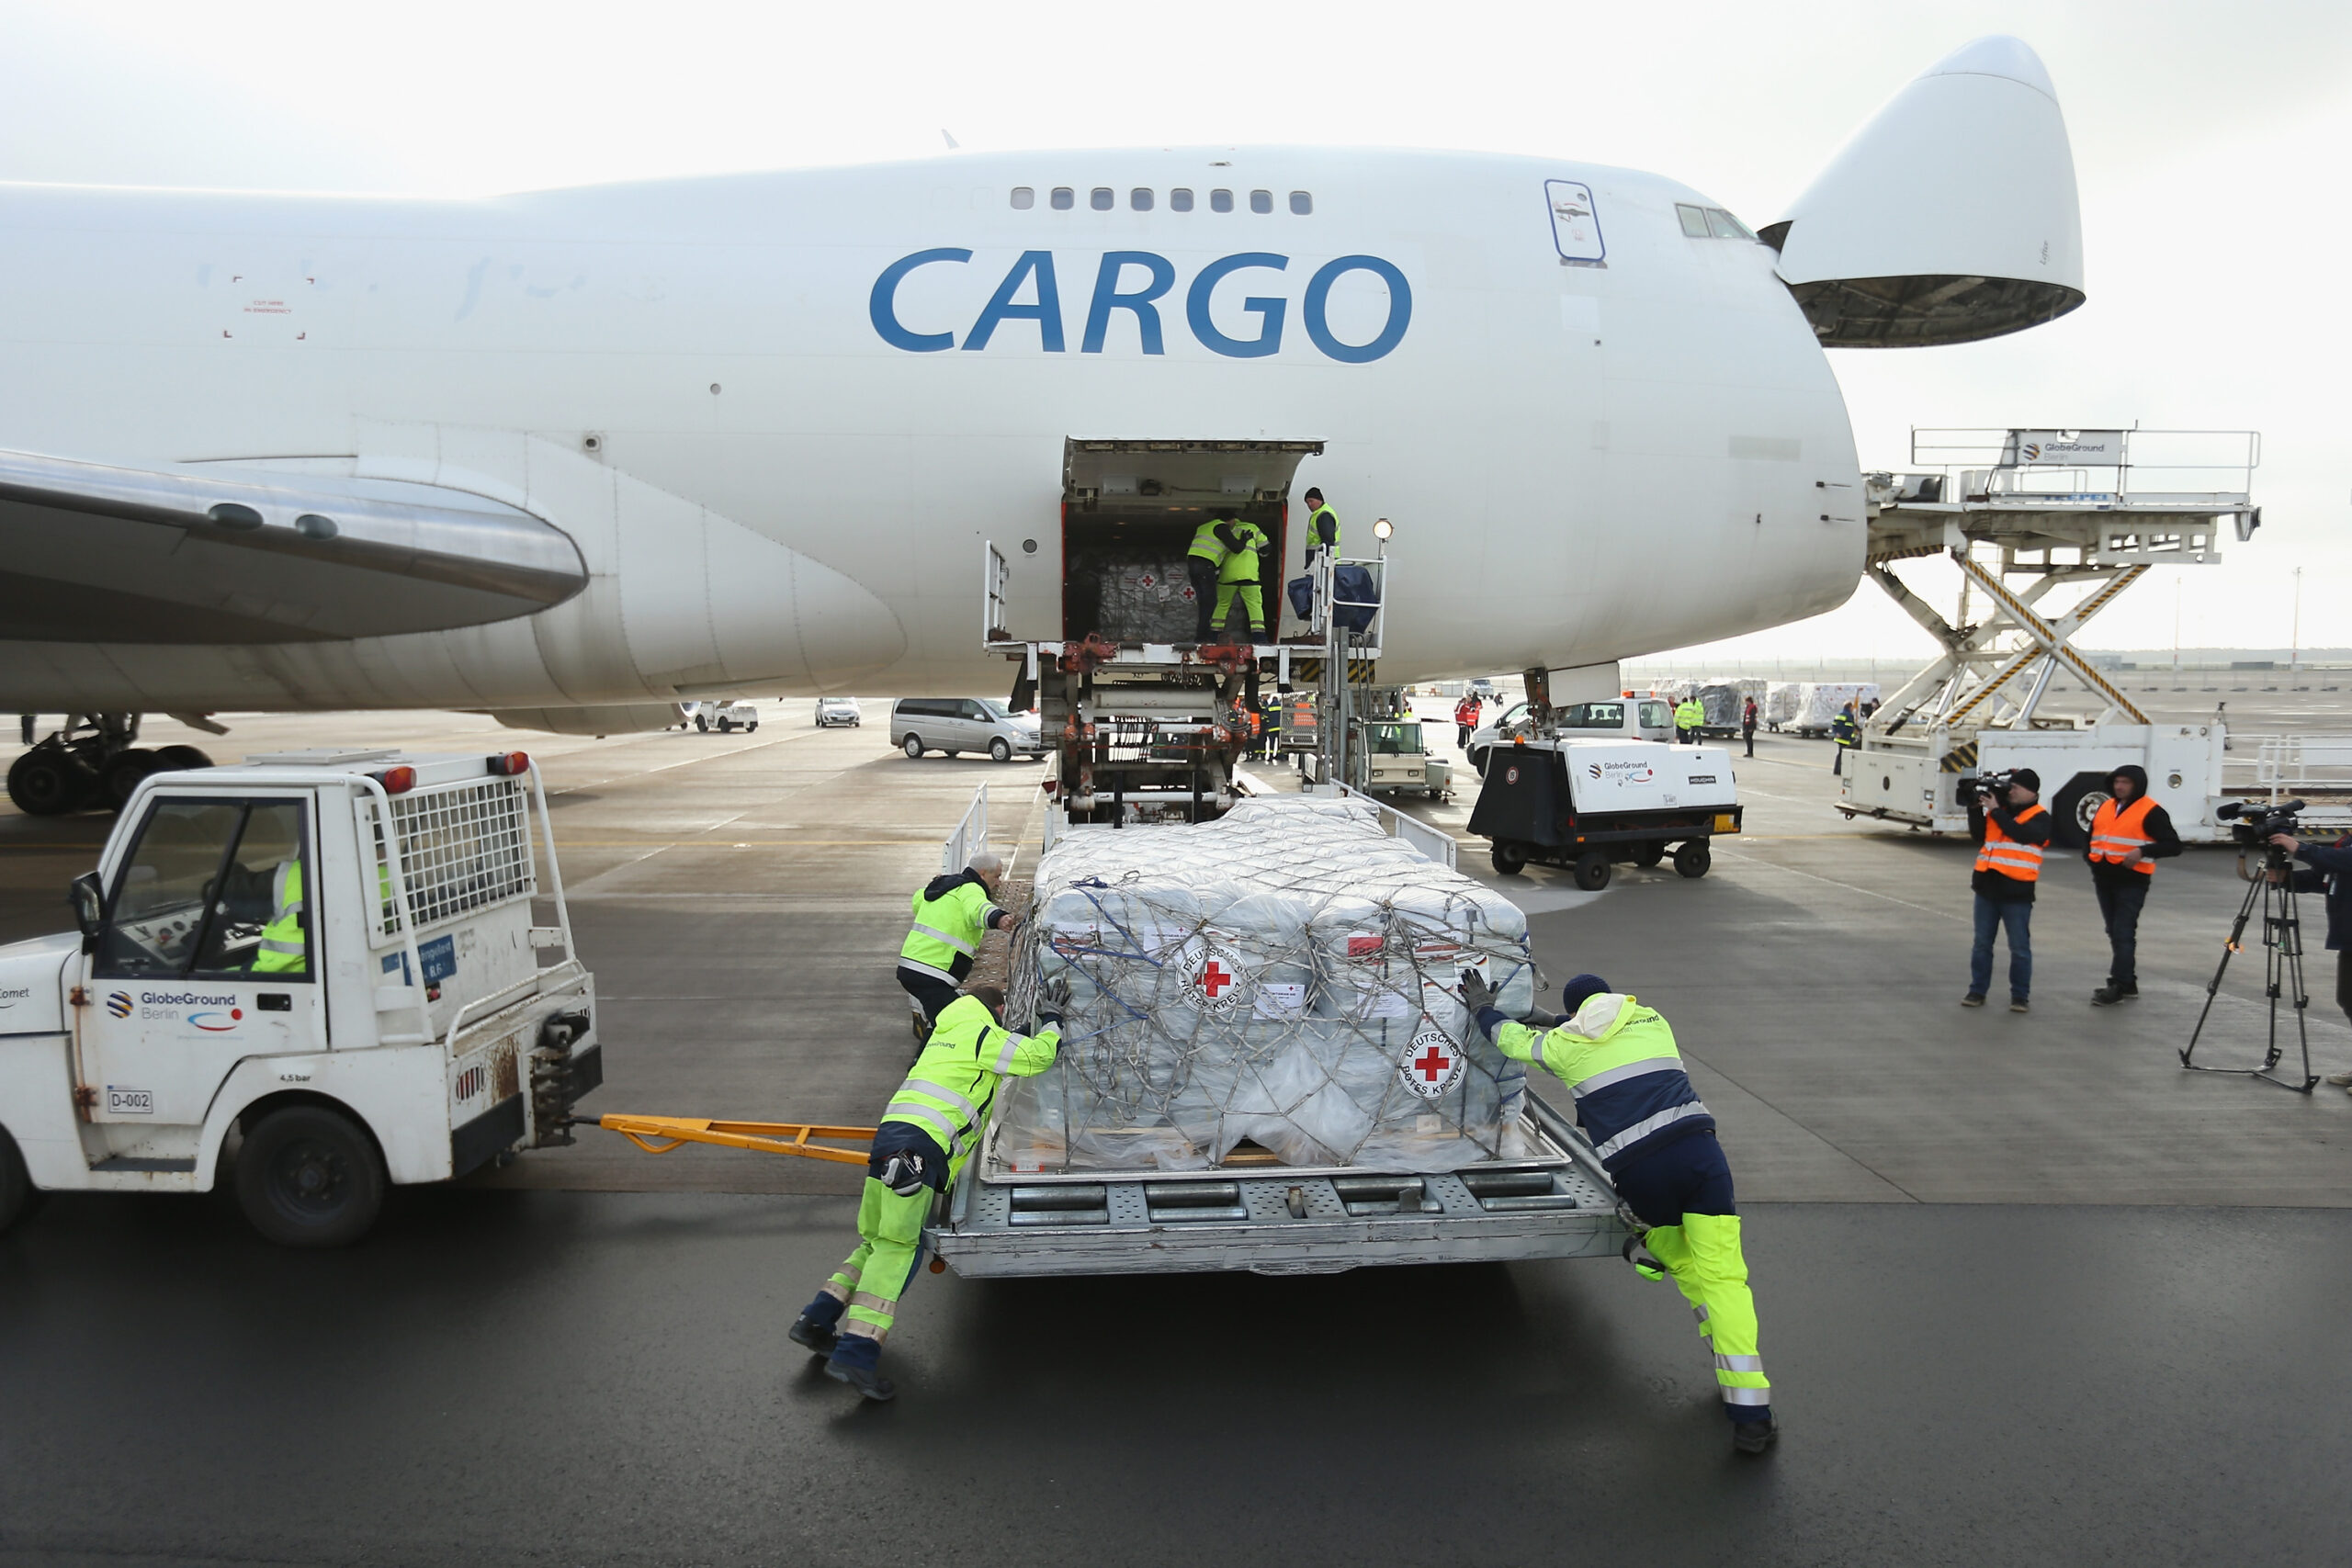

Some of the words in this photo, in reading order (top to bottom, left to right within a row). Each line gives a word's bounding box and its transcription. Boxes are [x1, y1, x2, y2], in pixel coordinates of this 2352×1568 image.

[869, 247, 1413, 364] CARGO
[2045, 443, 2105, 452] GlobeGround
[1604, 761, 1648, 770] GlobeGround
[1605, 770, 1623, 779] Berlin
[141, 992, 236, 1006] GlobeGround
[141, 1007, 180, 1020] Berlin
[279, 1074, 295, 1082] 4,5
[295, 1074, 311, 1082] bar
[111, 1093, 150, 1108] D-002
